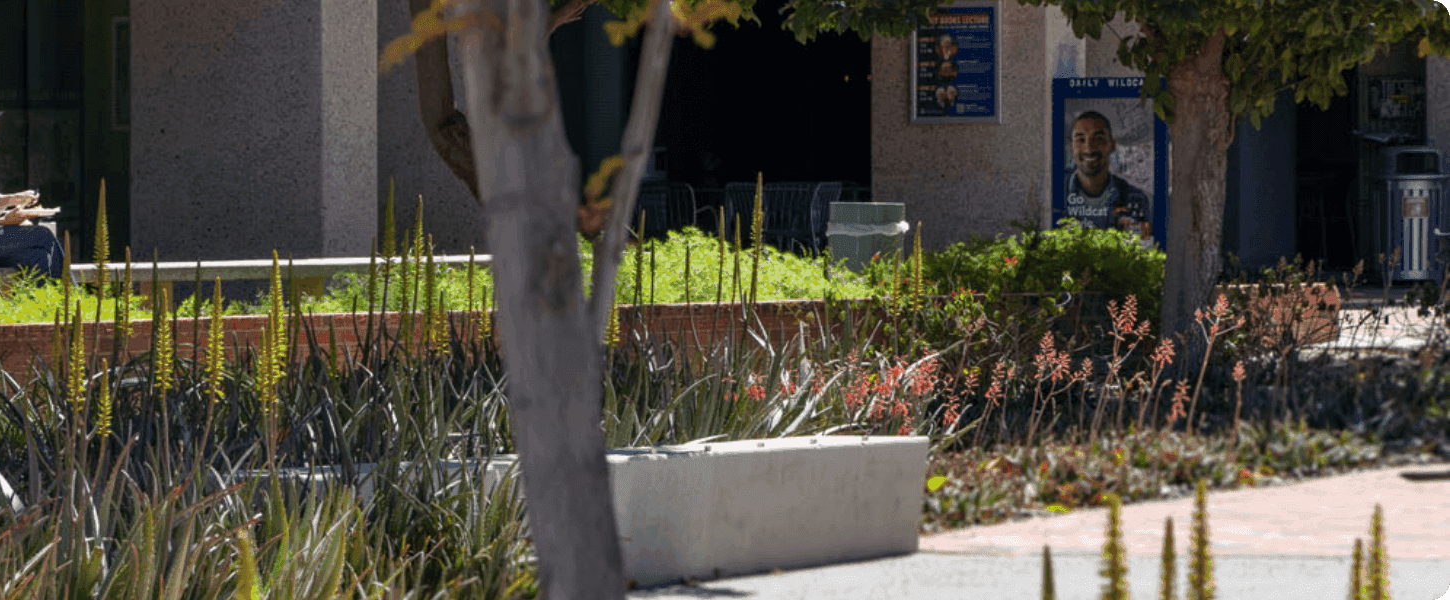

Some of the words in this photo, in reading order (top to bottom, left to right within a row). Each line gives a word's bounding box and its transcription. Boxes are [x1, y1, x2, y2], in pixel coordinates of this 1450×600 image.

[1069, 79, 1099, 88] DAILY
[1107, 79, 1144, 88] WILDCA
[1067, 193, 1084, 204] Go
[1067, 206, 1109, 216] Wildcat
